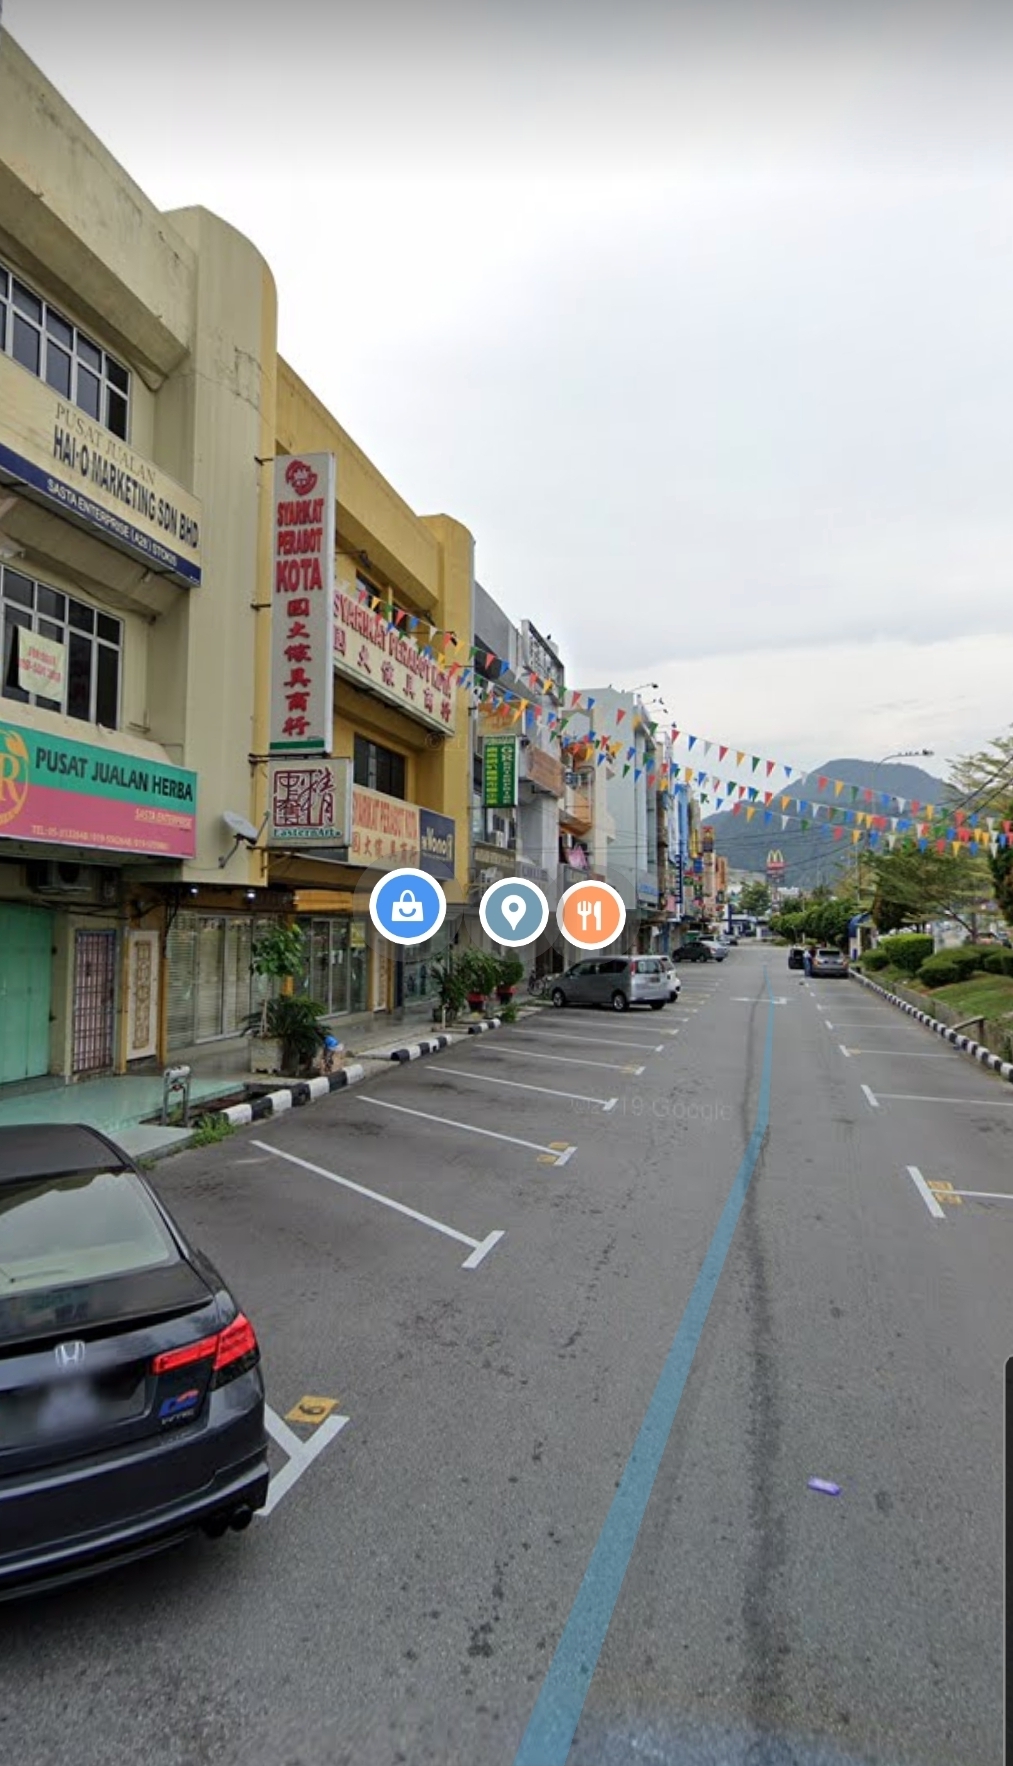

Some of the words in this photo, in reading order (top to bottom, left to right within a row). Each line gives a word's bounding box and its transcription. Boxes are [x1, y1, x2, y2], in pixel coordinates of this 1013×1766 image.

[55, 402, 102, 448] PUSAT
[106, 440, 155, 485] JUALAN
[47, 478, 77, 508] SASTA
[78, 499, 130, 537] ENTERPRISE
[92, 451, 156, 521] MARKETING
[157, 498, 178, 536] SDN
[179, 512, 199, 548] BHD
[277, 498, 324, 527] SYARIKAT
[277, 527, 323, 556] PERABOT
[276, 557, 323, 593] KOTA
[36, 747, 88, 778] PUSAT
[91, 761, 149, 792] JUALAN
[152, 775, 193, 802] HERBA
